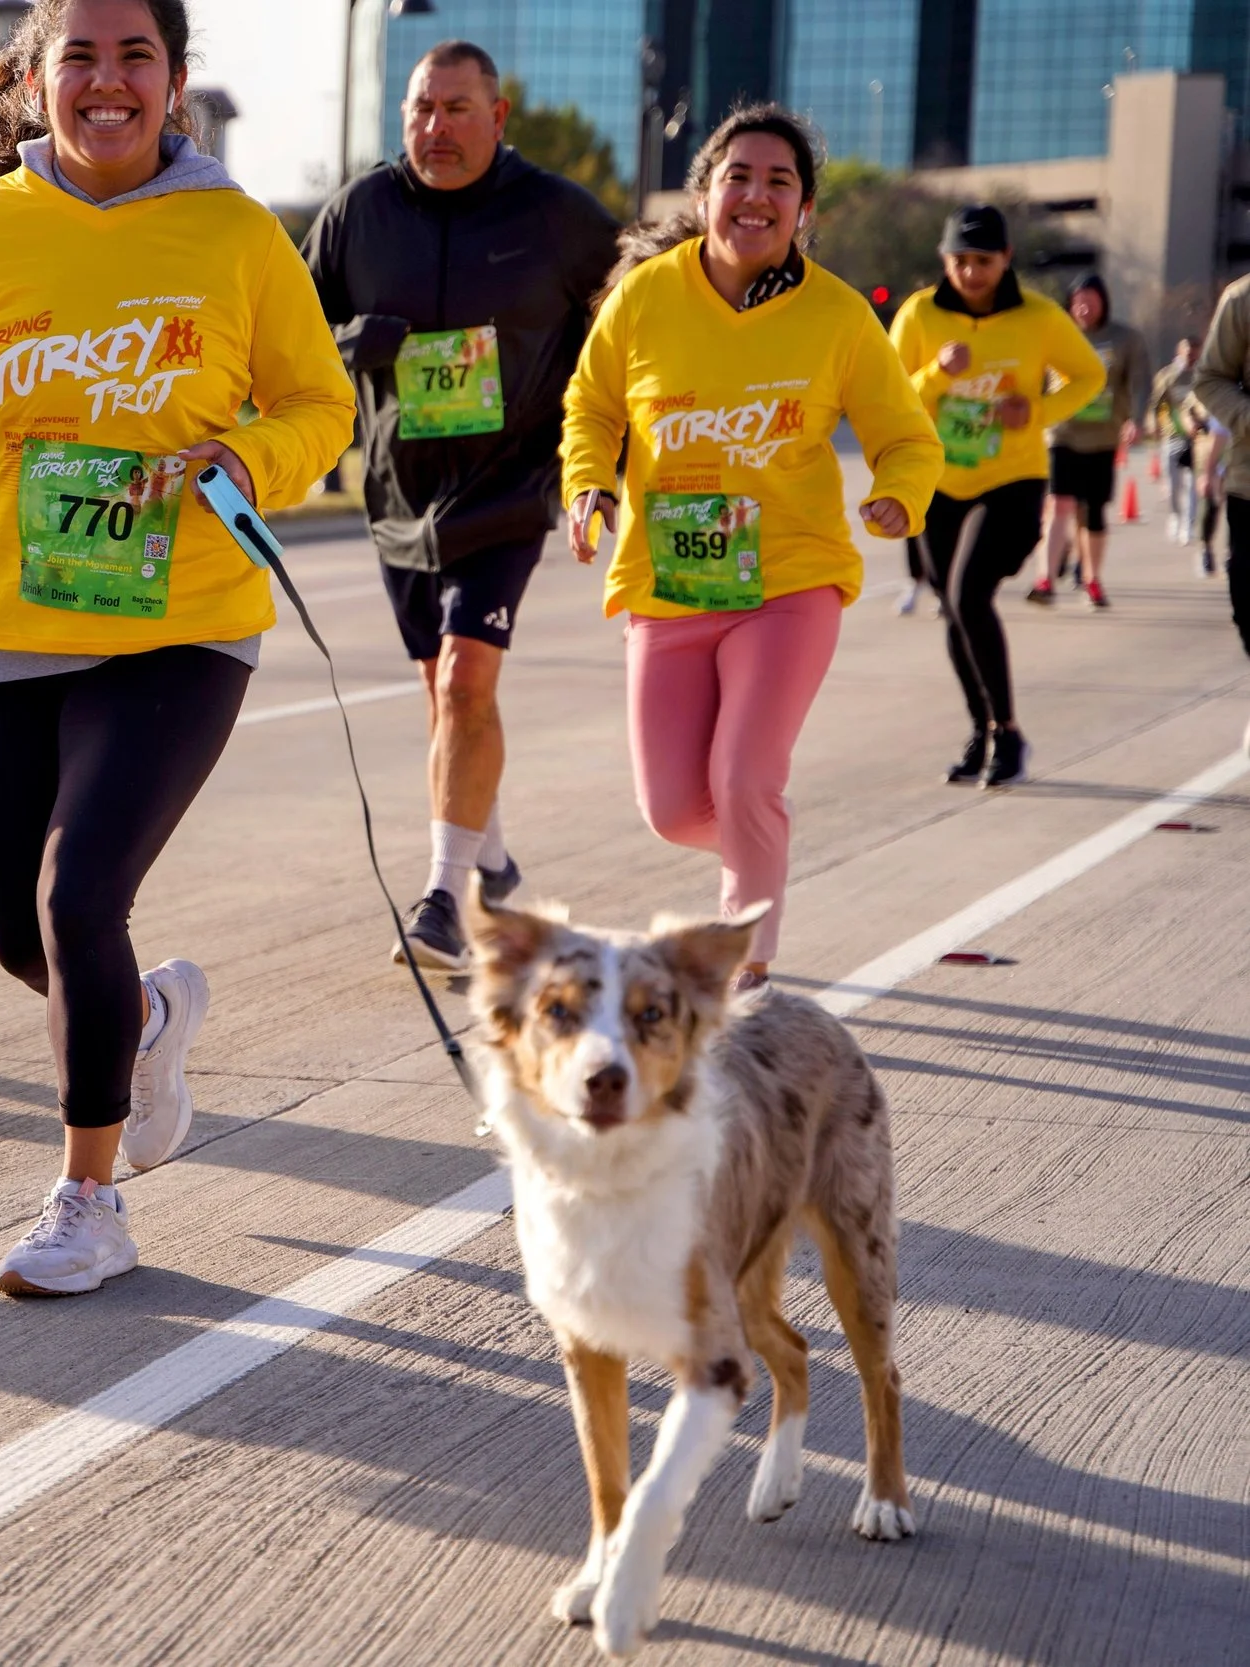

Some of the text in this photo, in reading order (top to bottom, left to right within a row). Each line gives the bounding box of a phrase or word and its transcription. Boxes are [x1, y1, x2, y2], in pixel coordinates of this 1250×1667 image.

[117, 295, 207, 310] IRVING MARATHON
[421, 364, 472, 393] 787
[85, 368, 201, 424] TROT
[33, 416, 80, 425] MOVEMENT
[649, 398, 780, 462] TURKEY
[4, 431, 79, 442] RUN TOGETHER
[37, 451, 65, 461] IRVING
[721, 437, 800, 470] TROT
[29, 456, 133, 480] TURKEY TROT
[97, 474, 120, 488] 5K
[59, 494, 135, 541] 770
[674, 530, 728, 561] 859
[47, 554, 65, 564] Join
[67, 557, 83, 567] the
[85, 560, 133, 573] Movement
[22, 581, 43, 597] Drink
[51, 588, 79, 603] Drink
[94, 594, 120, 608] Food
[141, 605, 152, 613] 770
